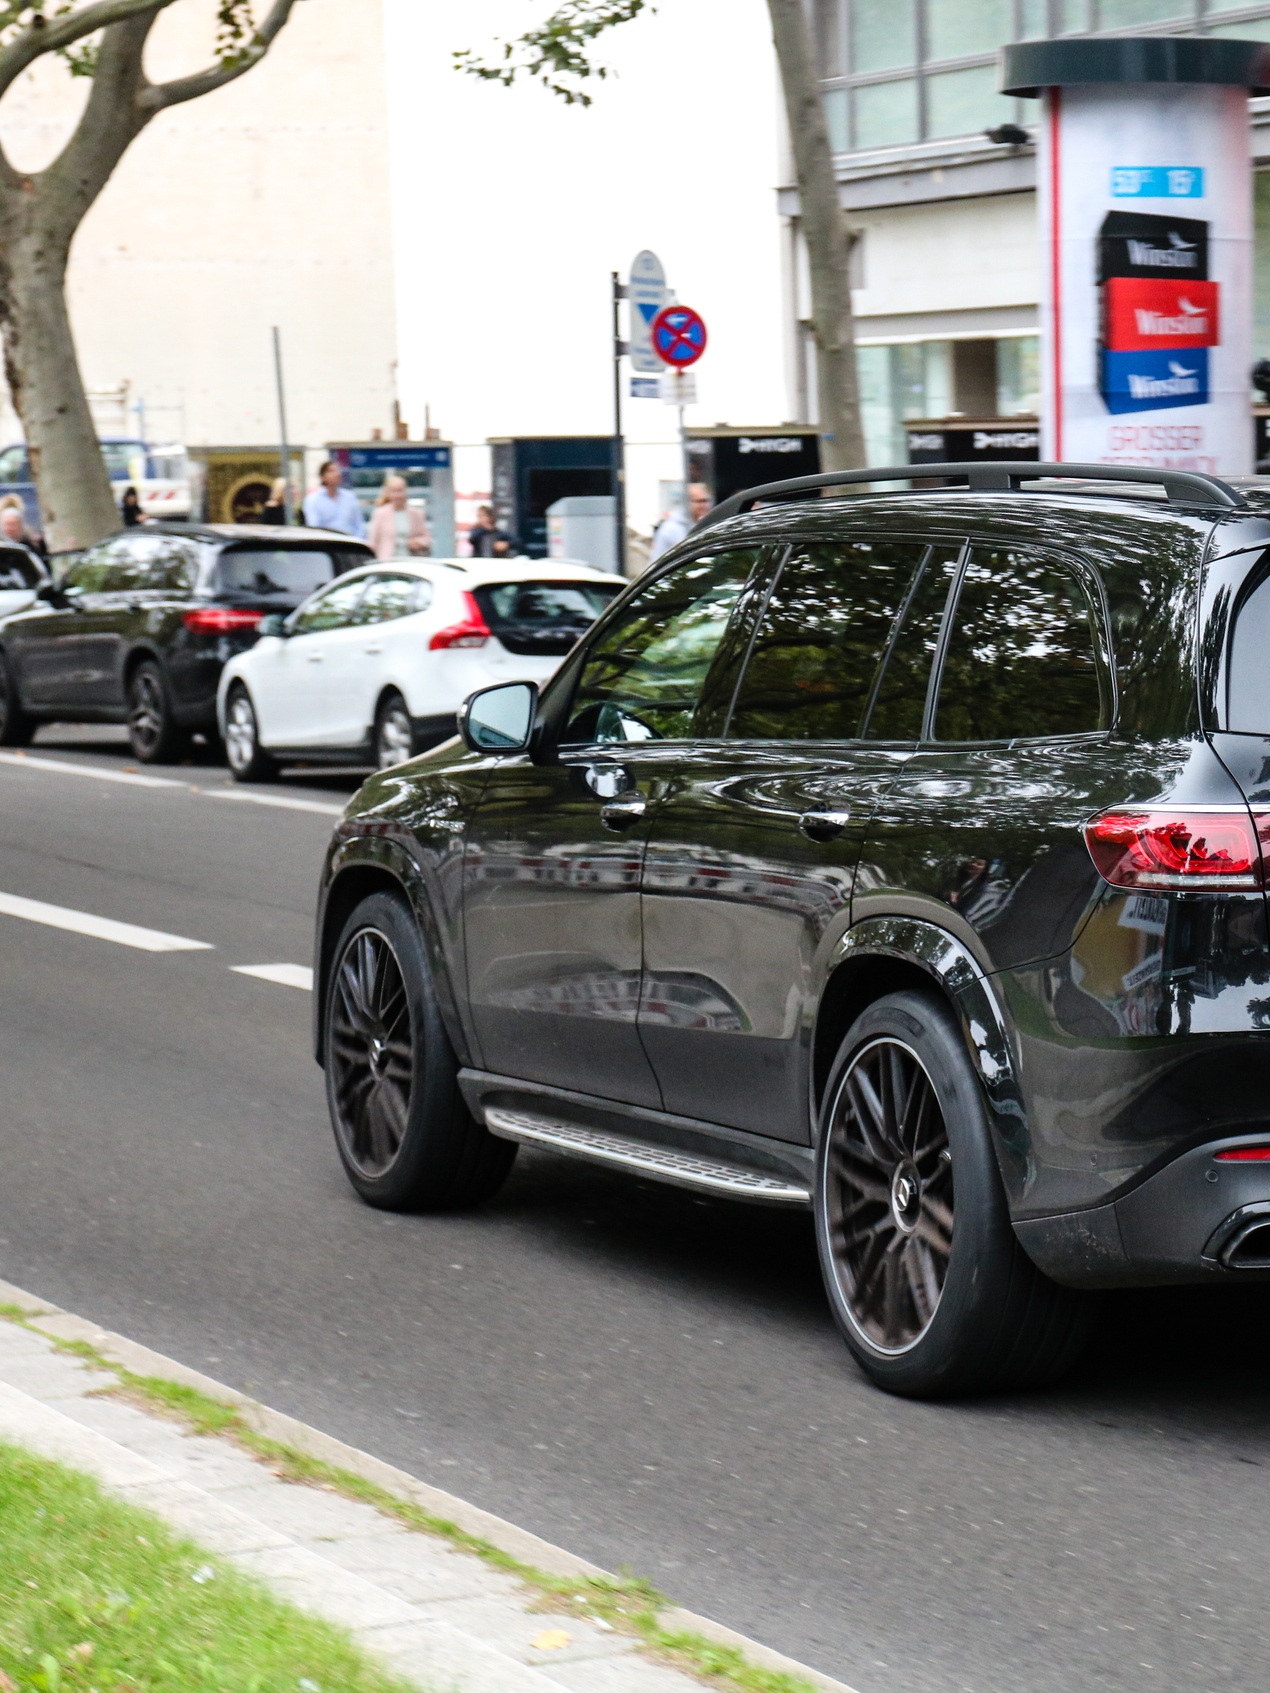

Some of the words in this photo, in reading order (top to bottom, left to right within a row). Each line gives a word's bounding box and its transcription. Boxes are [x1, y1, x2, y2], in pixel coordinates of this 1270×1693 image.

[1127, 239, 1198, 268] Winston
[1134, 308, 1208, 335] Winston
[1127, 374, 1199, 399] Winston
